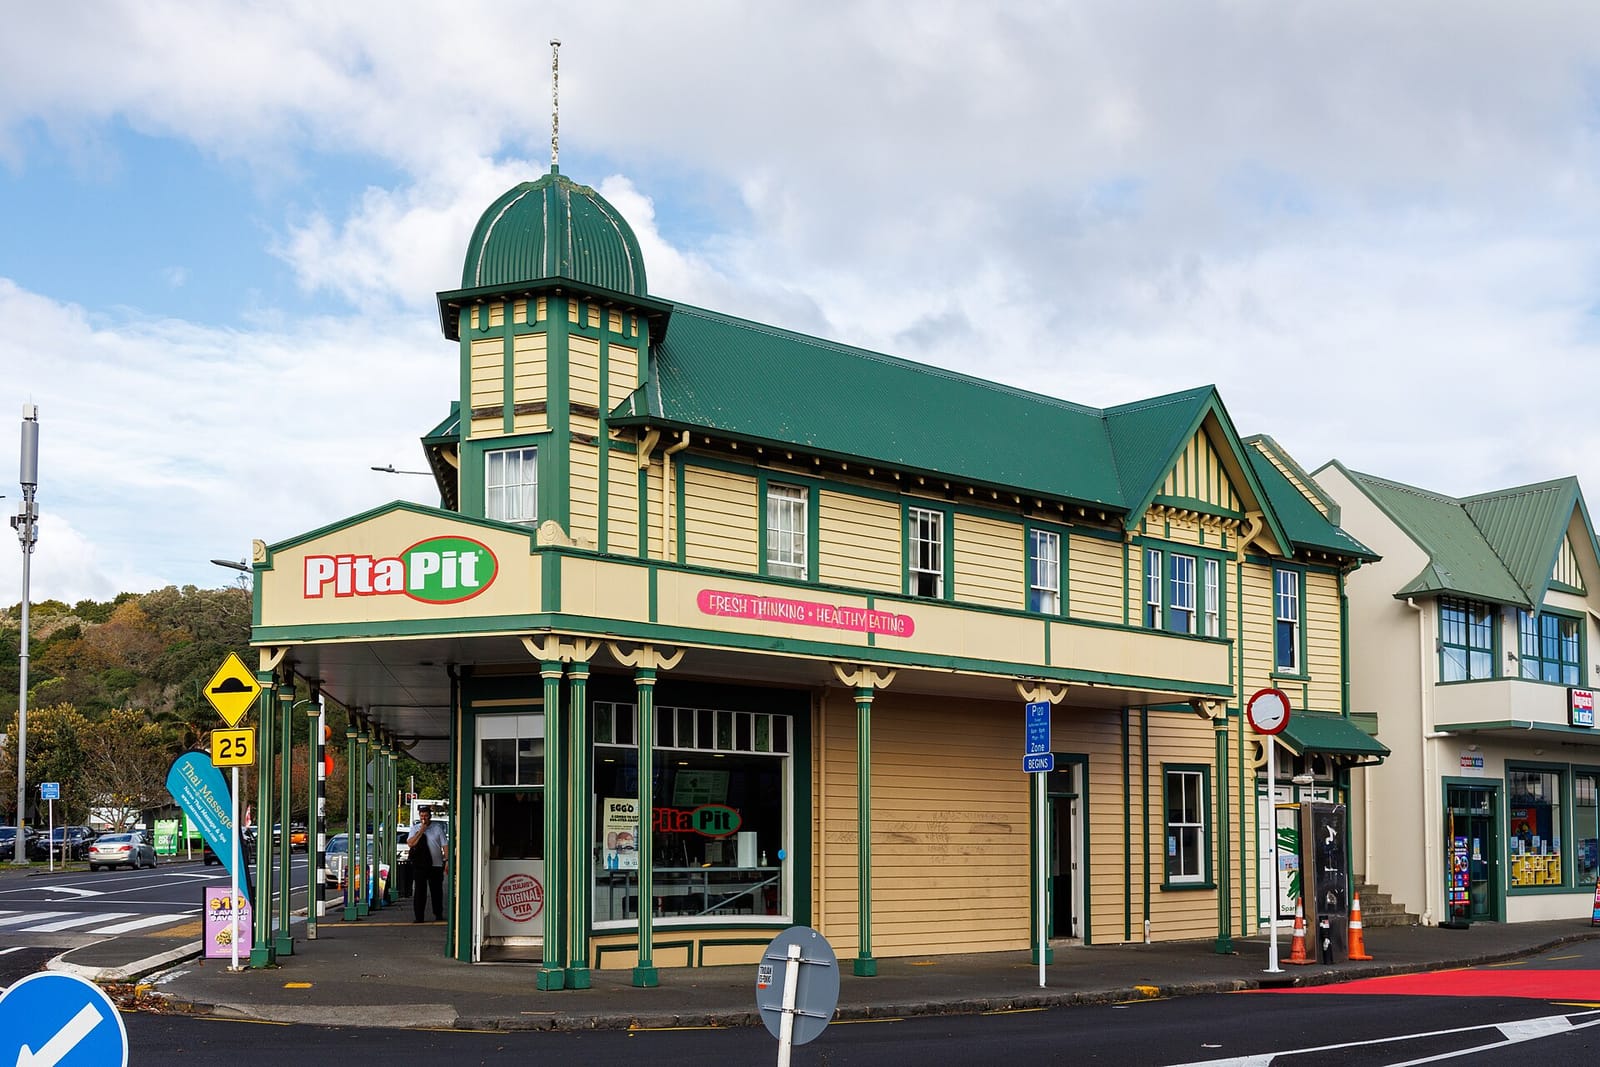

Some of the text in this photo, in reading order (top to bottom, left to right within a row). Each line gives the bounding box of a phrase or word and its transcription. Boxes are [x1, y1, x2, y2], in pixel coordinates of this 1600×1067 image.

[306, 551, 480, 595] Pita Pit
[709, 595, 905, 633] FRESH THINKING HEALTHY EATING
[219, 737, 247, 758] 25
[1031, 742, 1045, 753] Zone
[1028, 758, 1048, 769] BEGINS
[182, 761, 233, 829] Thai Massage
[700, 810, 731, 830] Pit
[500, 887, 541, 908] ORIGINAL
[512, 903, 533, 914] PITA
